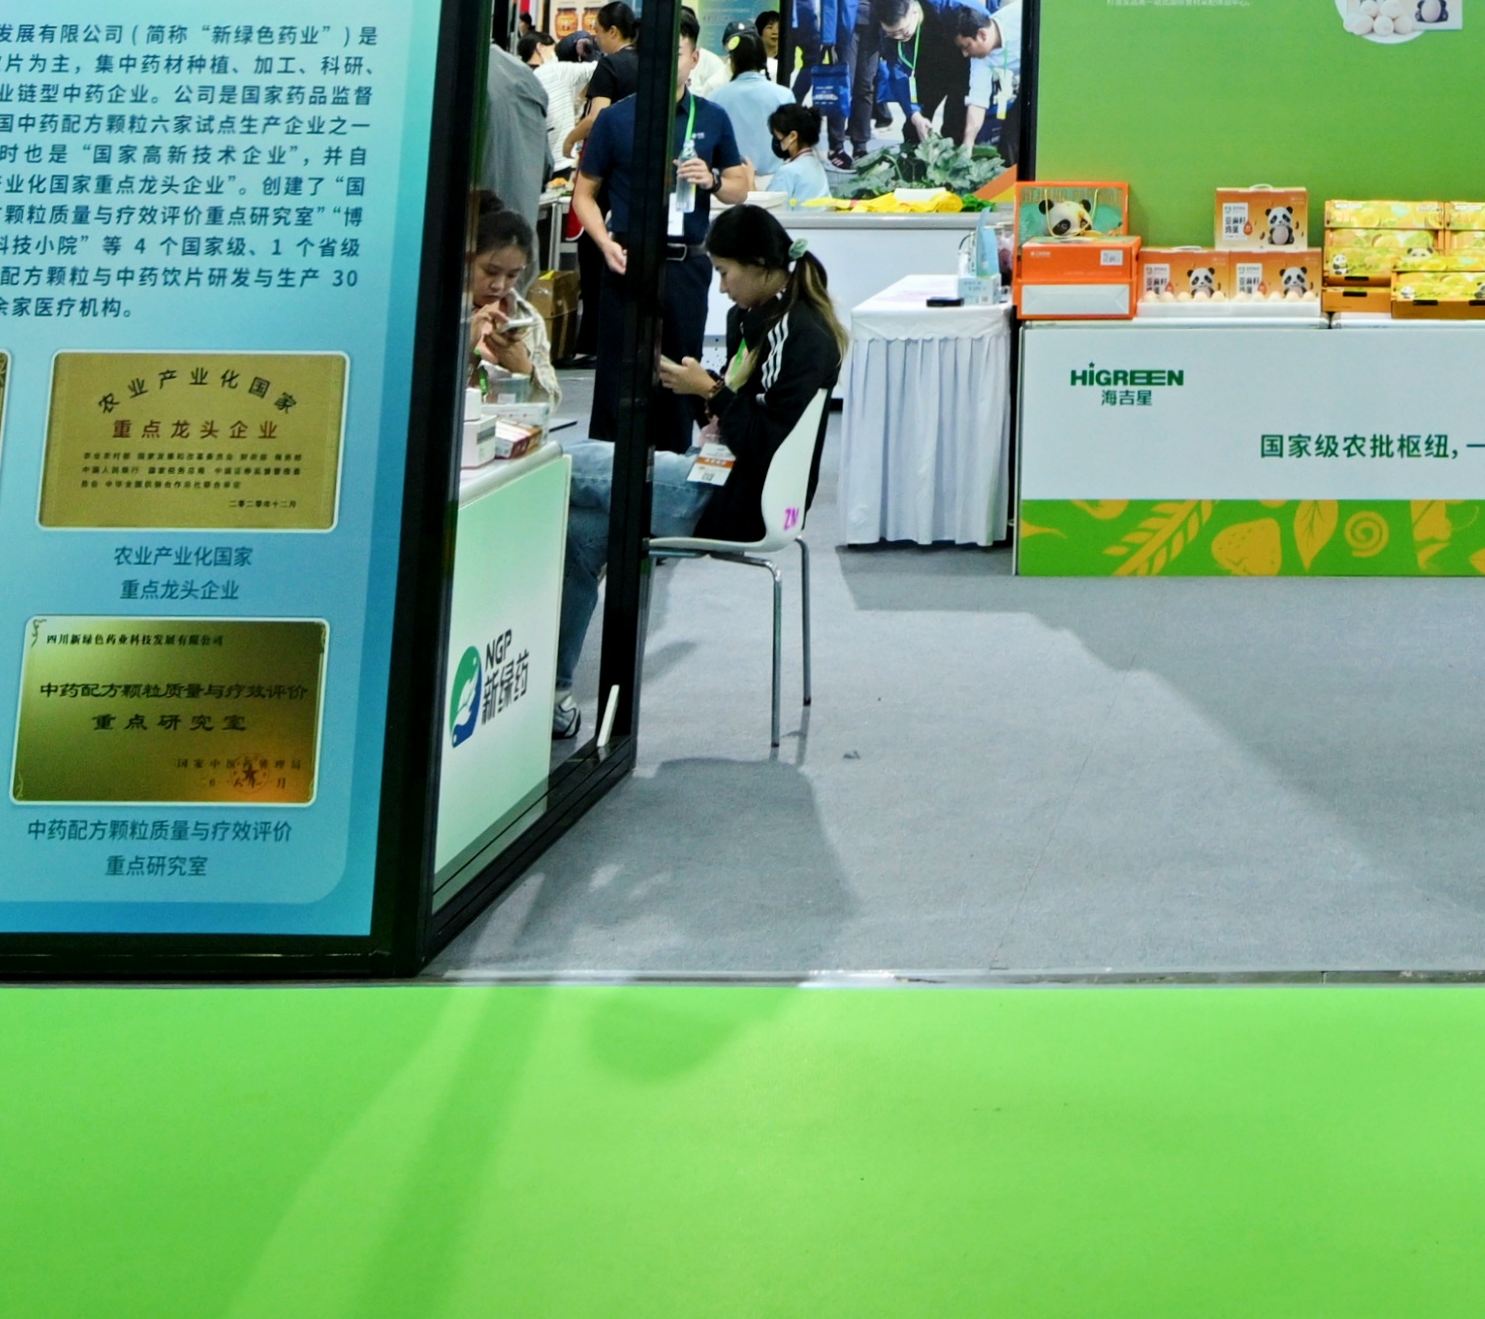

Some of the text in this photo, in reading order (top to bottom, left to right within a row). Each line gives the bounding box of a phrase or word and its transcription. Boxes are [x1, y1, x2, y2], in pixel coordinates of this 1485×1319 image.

[98, 367, 297, 414] 农业产业化国家
[1101, 389, 1153, 407] 海吉星
[112, 419, 278, 440] 重点龙头企业
[114, 545, 254, 568] 农业产业化国家
[120, 578, 240, 602] 重点龙头企业
[485, 628, 512, 672] NGP
[40, 682, 308, 700] 中药配方颗粒质量与疗效评价
[481, 648, 530, 725] 新绿药
[92, 713, 247, 731] 重点研究室
[27, 819, 292, 843] 中药配方颗粒质量与疗效评价
[105, 855, 208, 877] 重点研究室
